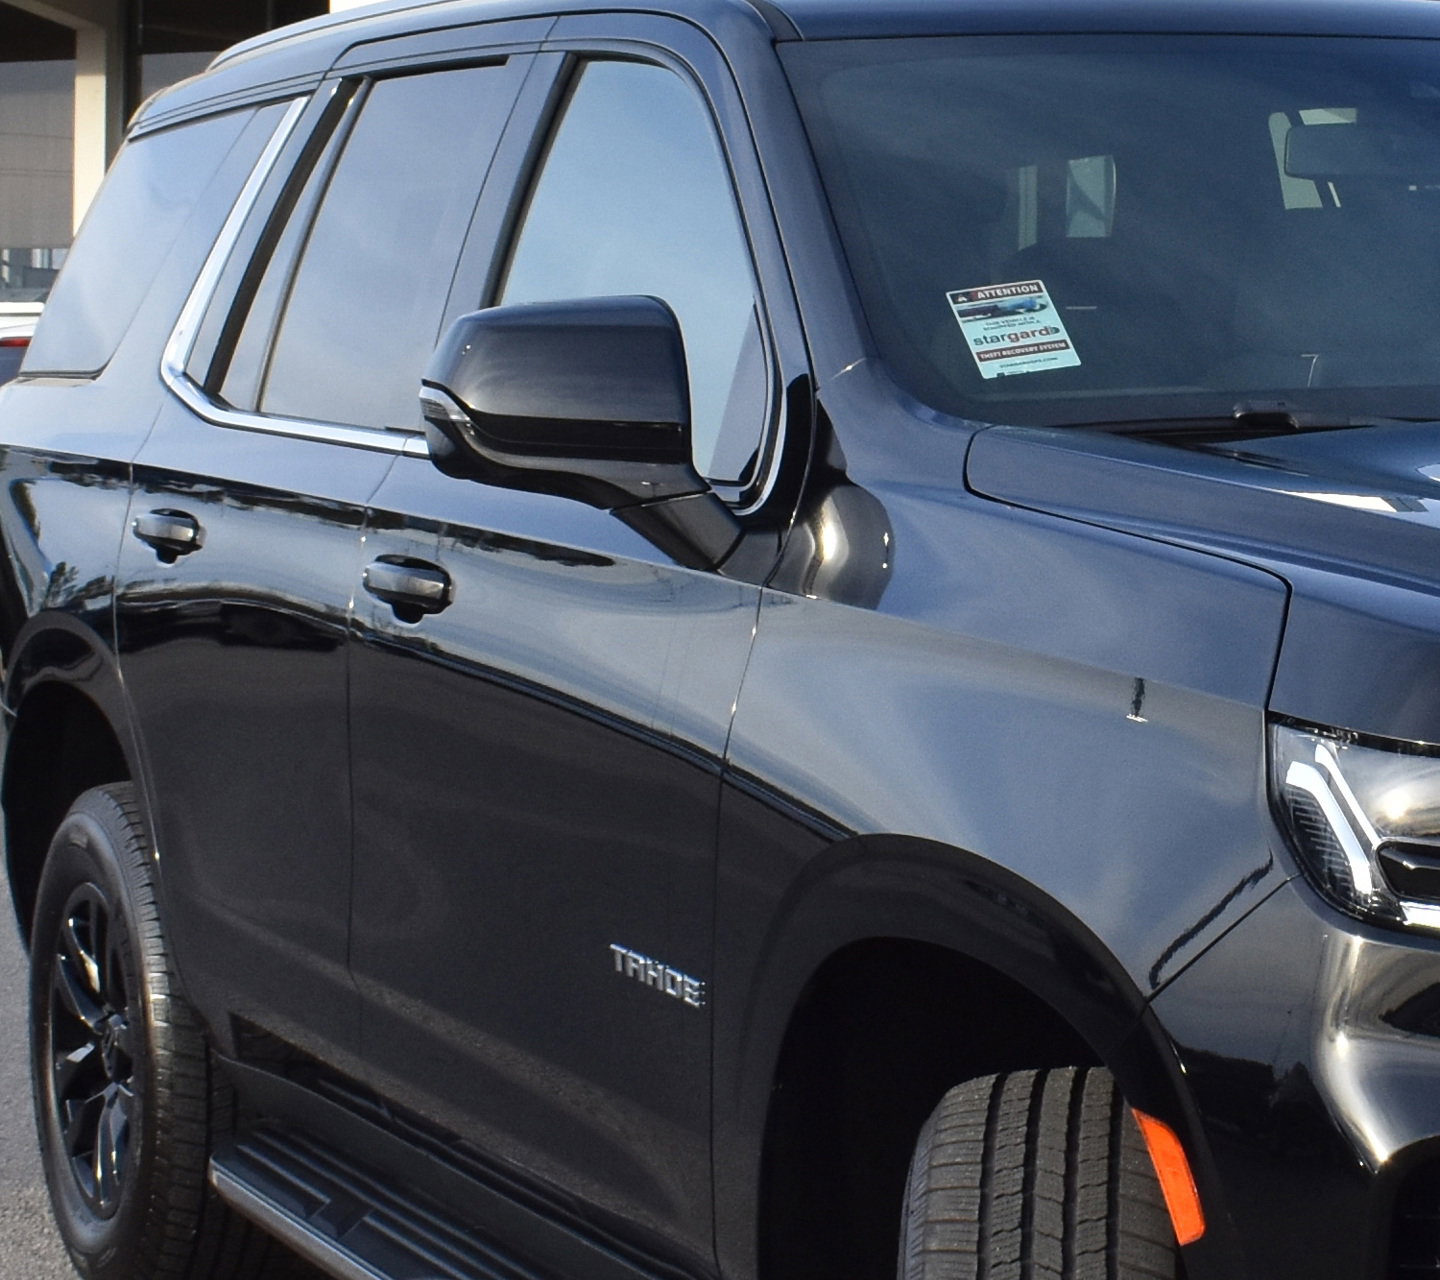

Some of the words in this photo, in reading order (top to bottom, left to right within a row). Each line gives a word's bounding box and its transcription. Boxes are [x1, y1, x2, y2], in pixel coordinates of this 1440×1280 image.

[977, 284, 1039, 300] ATTENTION
[973, 325, 1050, 346] stargard
[609, 943, 706, 1009] TAHOE
